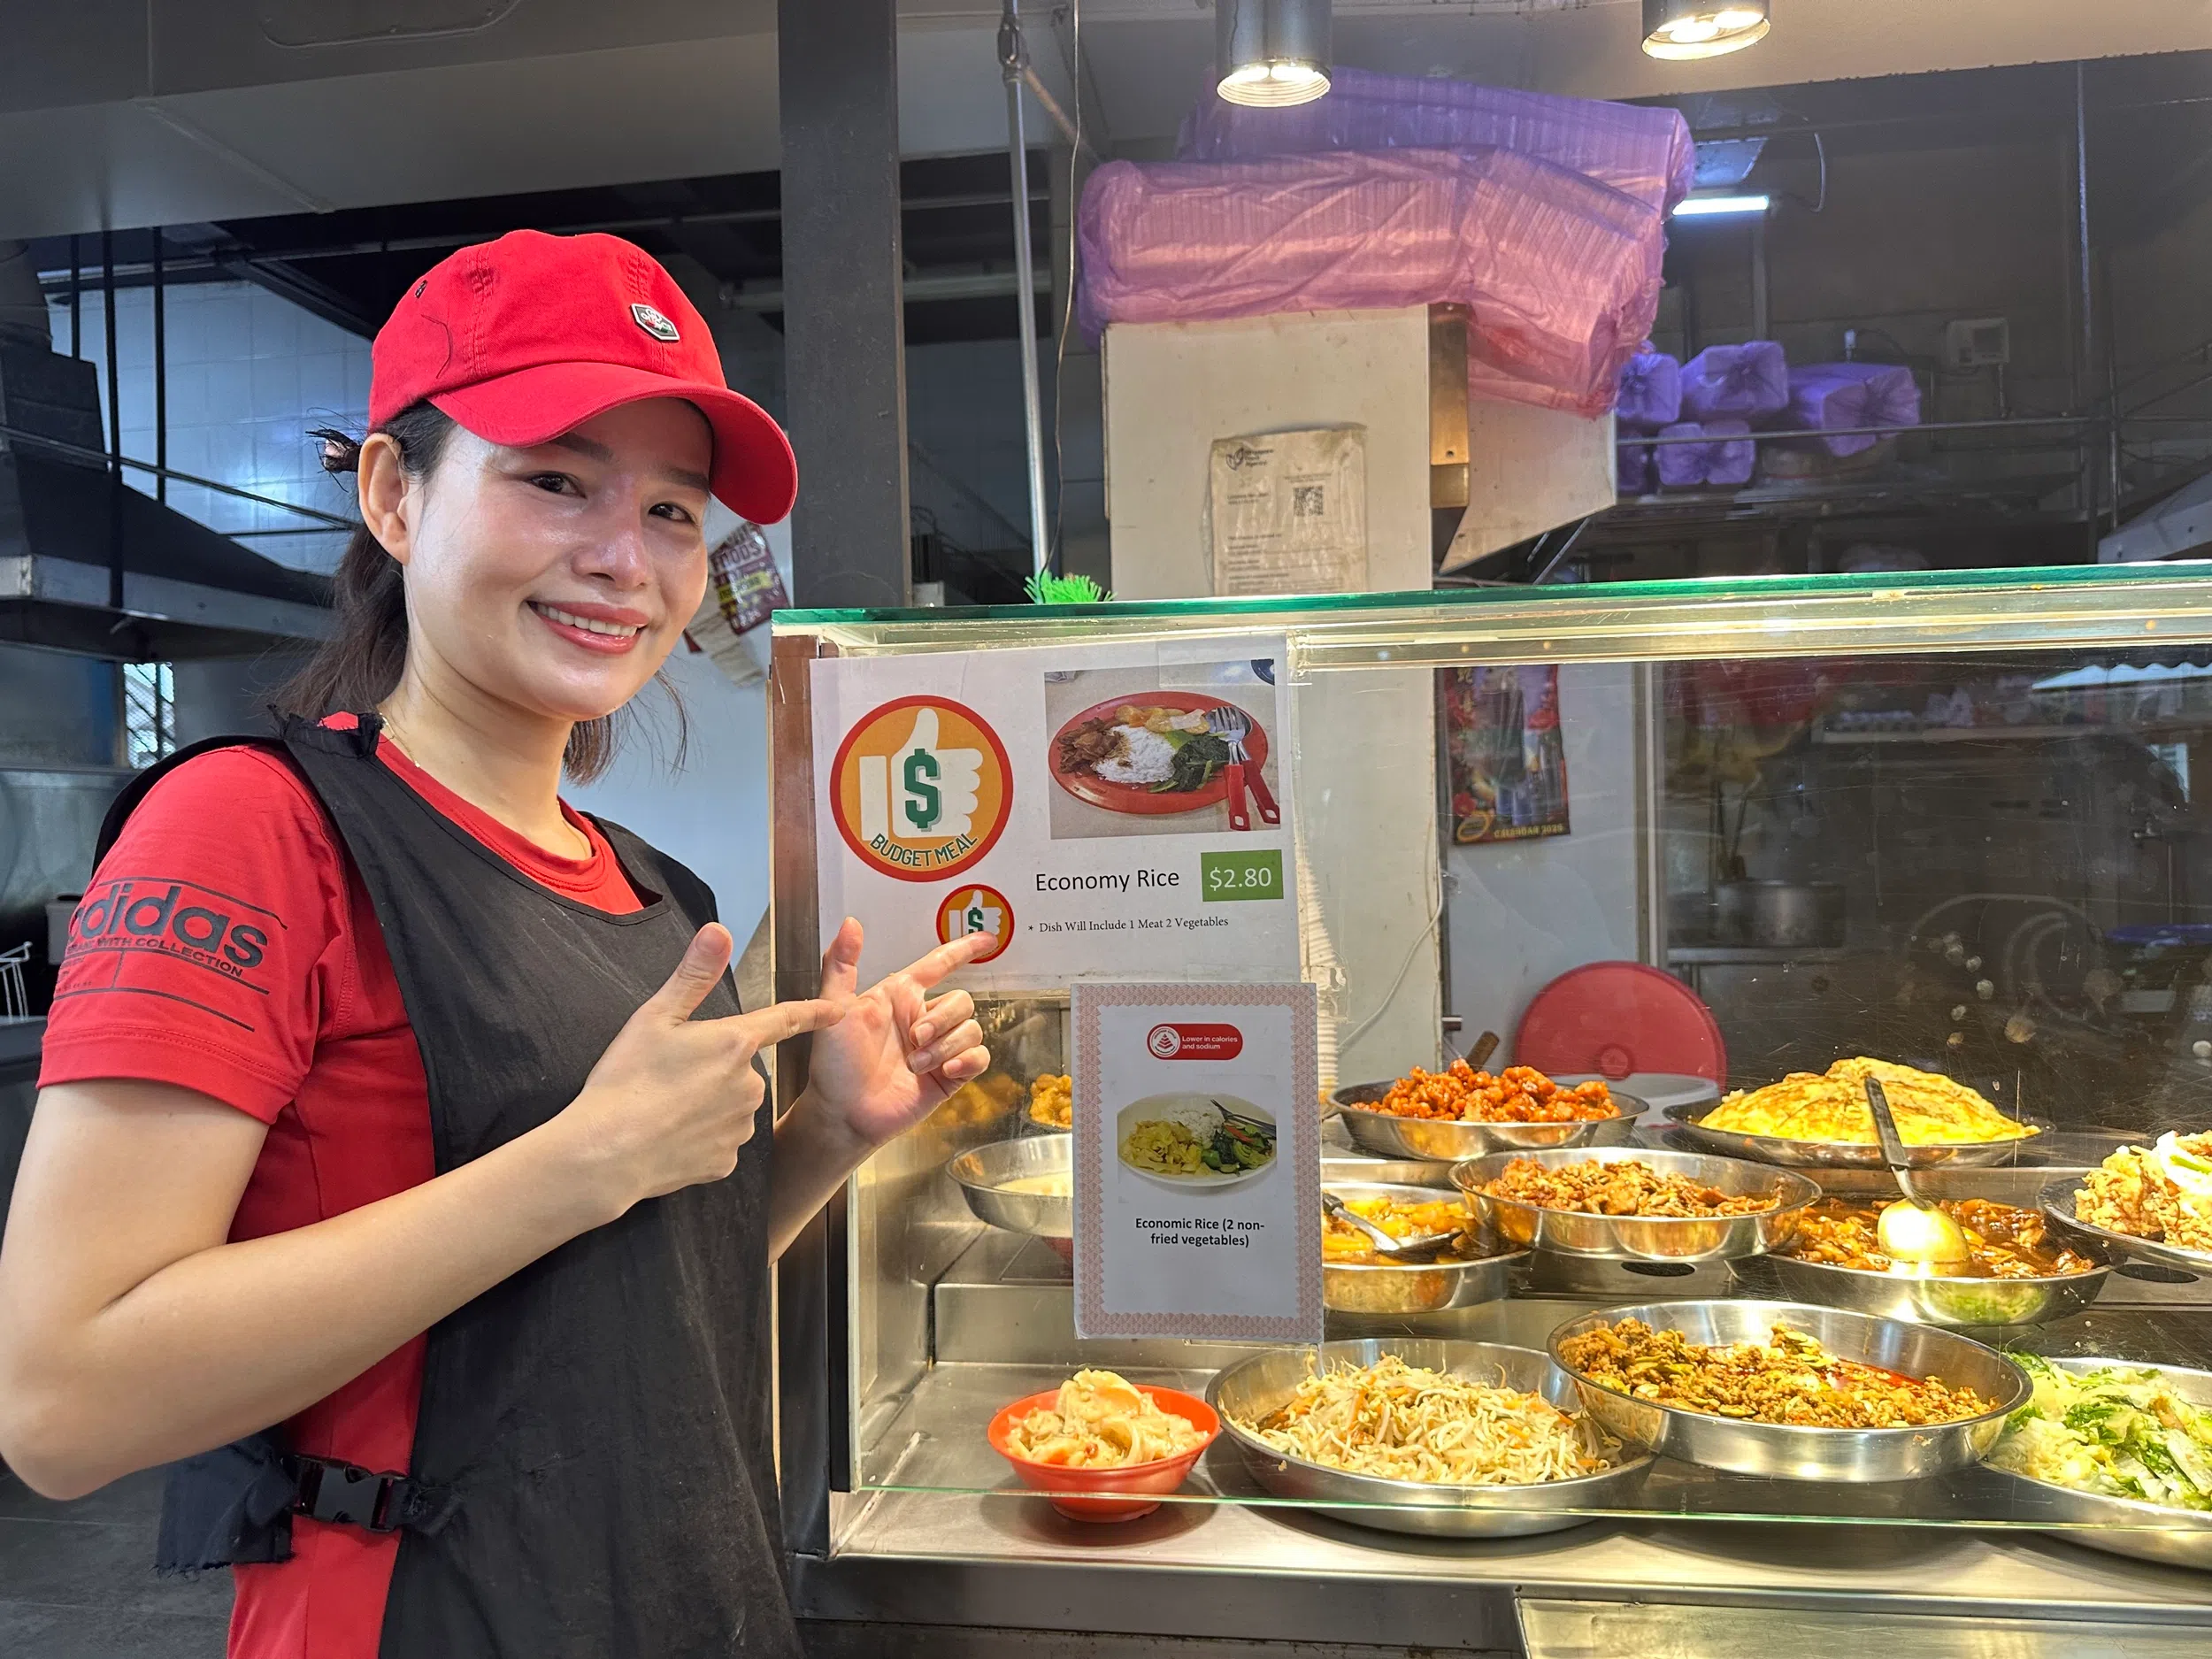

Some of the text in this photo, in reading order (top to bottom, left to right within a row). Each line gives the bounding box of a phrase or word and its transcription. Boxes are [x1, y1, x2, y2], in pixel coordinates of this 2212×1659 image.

[870, 833, 978, 867] BUDGET MEAL
[1035, 869, 1179, 893] Economy Rice
[1209, 867, 1271, 891] $2.80
[1039, 916, 1229, 933] Dish Will Include 1 Meat 2 Vegetables
[98, 937, 132, 947] WITH
[135, 937, 243, 978] COLLECTION
[1135, 1217, 1264, 1232] Economic Rice (2 non-
[1150, 1233, 1249, 1248] fried vegetables)
